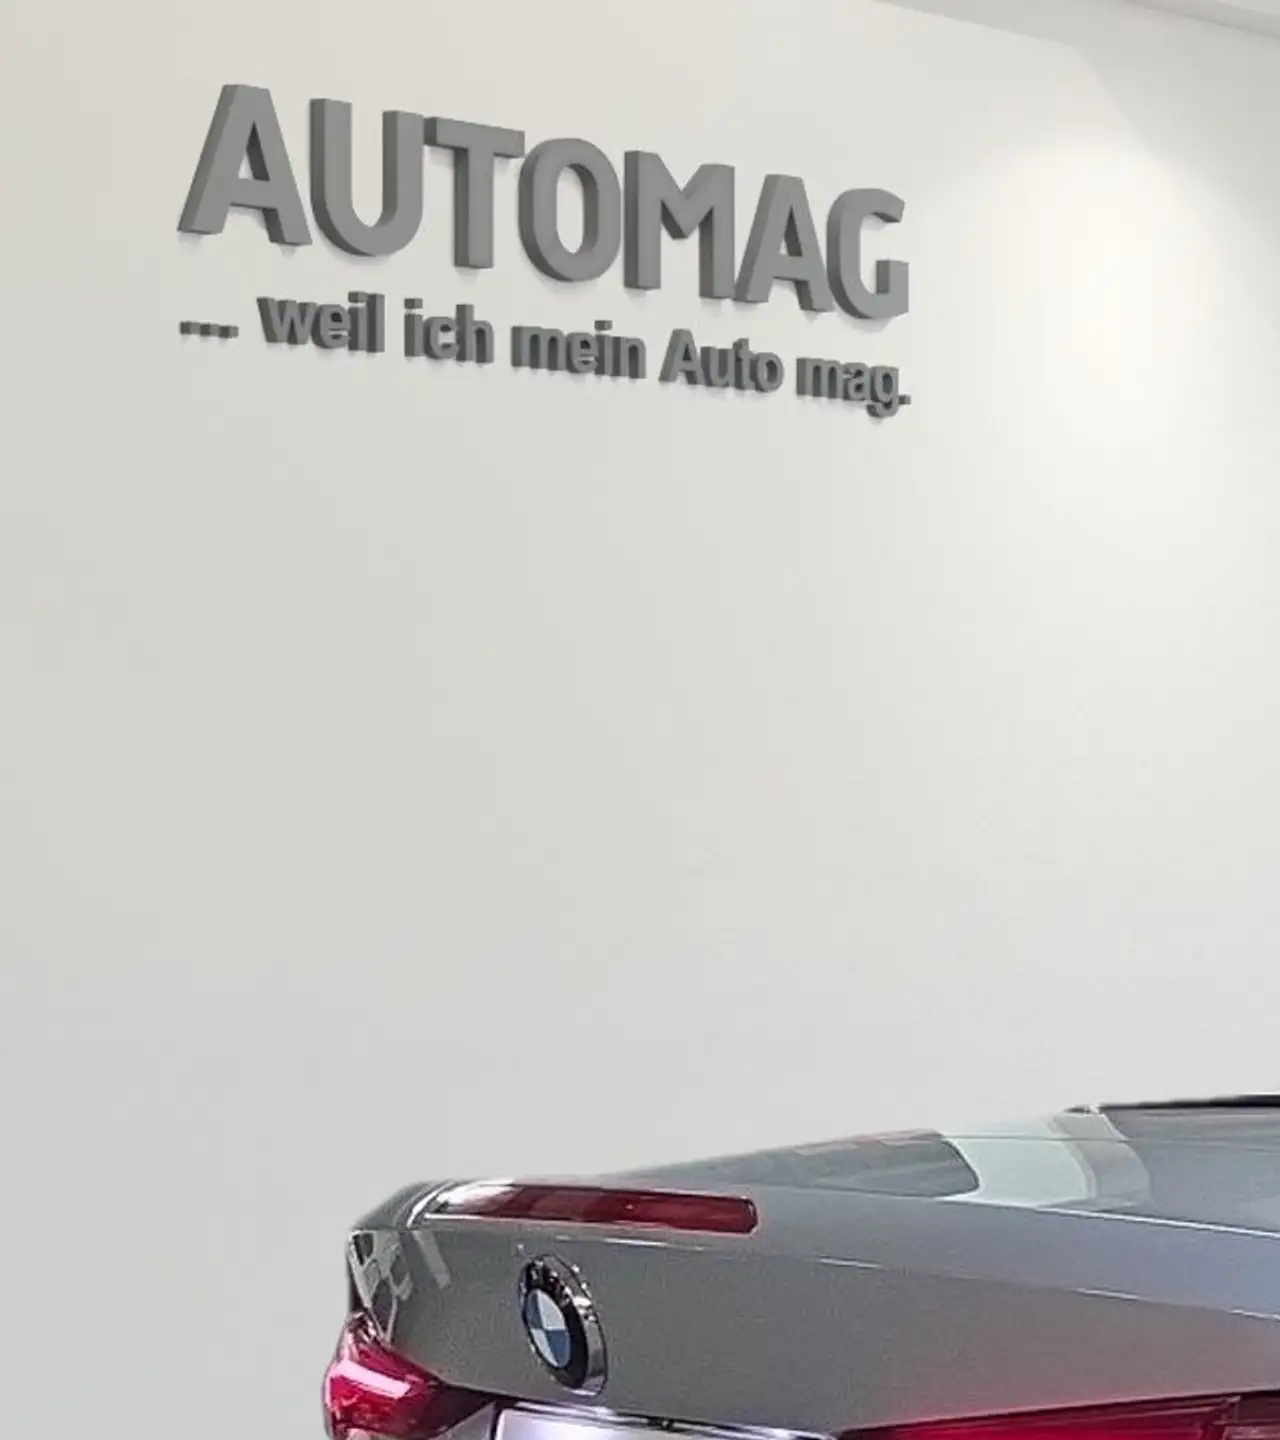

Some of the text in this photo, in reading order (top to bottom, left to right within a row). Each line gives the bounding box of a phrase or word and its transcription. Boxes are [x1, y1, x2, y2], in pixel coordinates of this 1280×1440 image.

[177, 84, 909, 320] AUTOMAG
[256, 291, 385, 352] weil
[404, 298, 494, 363] ich
[511, 320, 646, 379] mein
[658, 328, 784, 393] Auto
[796, 357, 911, 417] mag.
